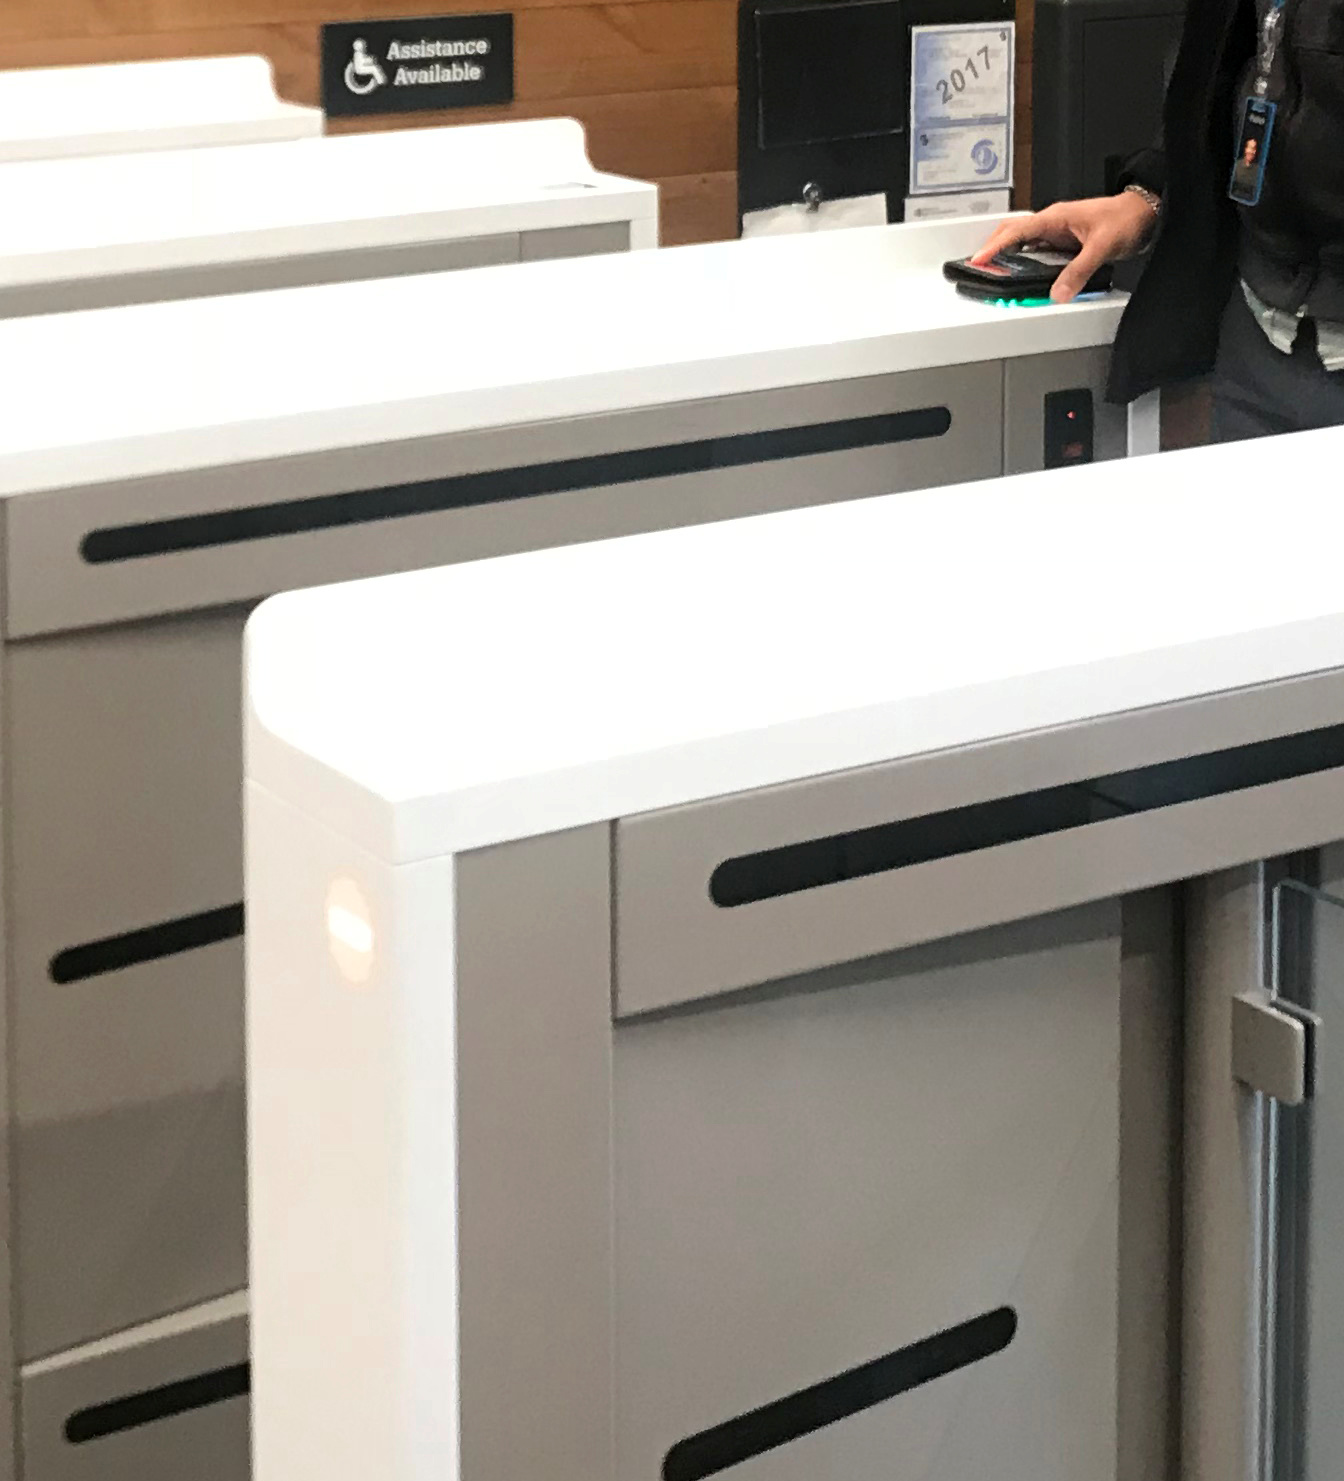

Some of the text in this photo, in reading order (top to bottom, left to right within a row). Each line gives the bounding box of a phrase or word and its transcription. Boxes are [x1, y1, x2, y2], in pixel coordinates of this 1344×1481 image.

[386, 39, 492, 61] Assistance
[394, 61, 482, 86] Available
[936, 45, 991, 105] 2017
